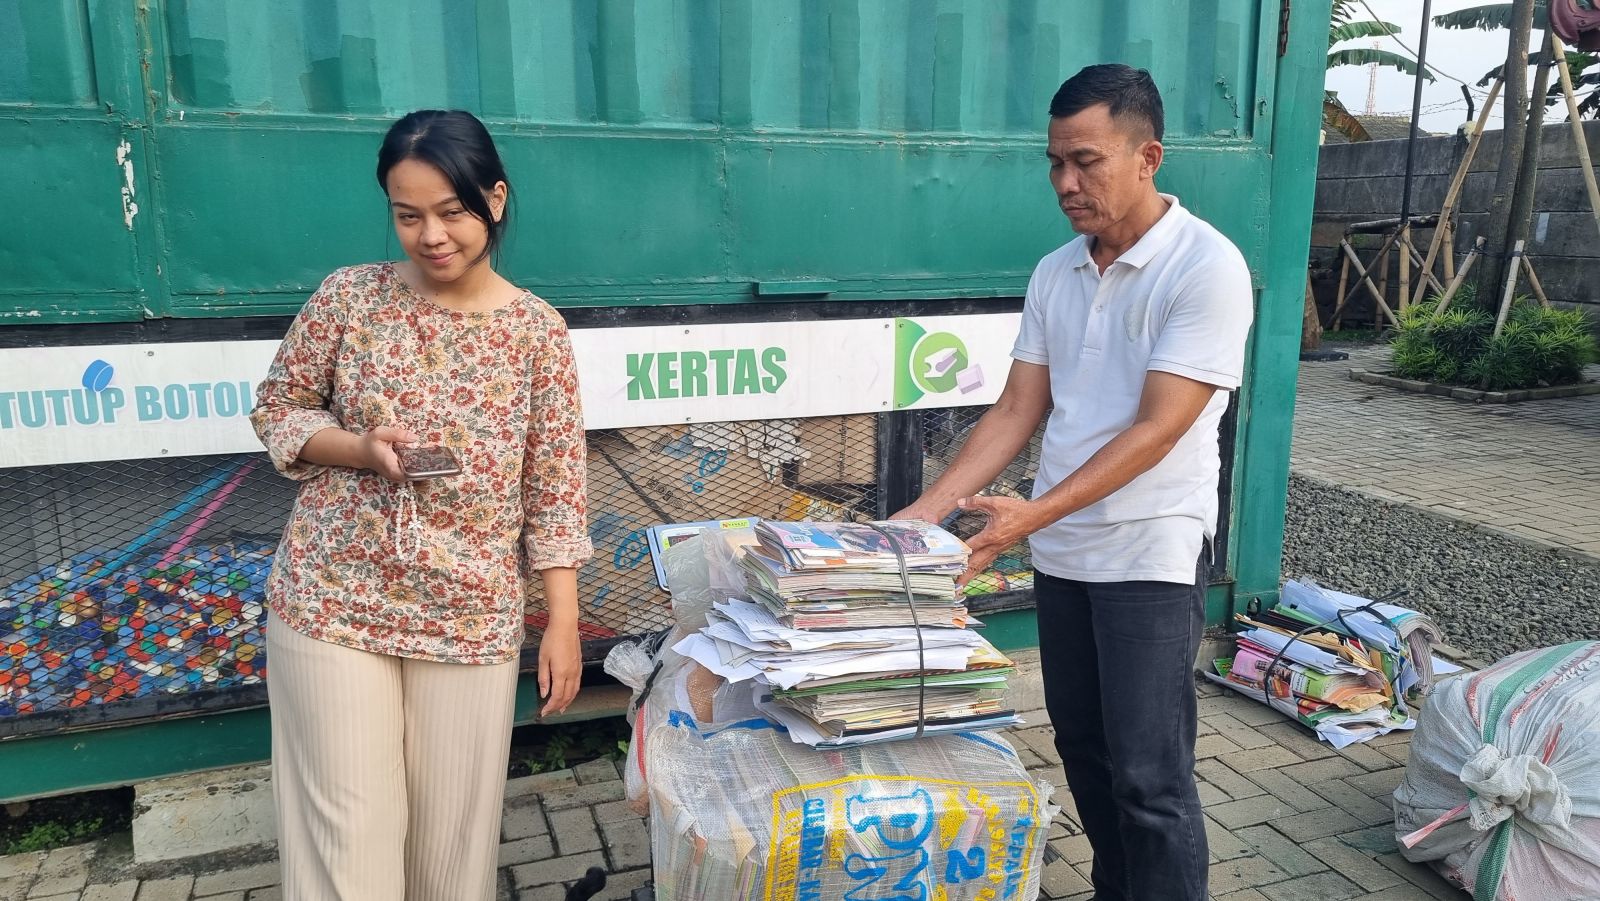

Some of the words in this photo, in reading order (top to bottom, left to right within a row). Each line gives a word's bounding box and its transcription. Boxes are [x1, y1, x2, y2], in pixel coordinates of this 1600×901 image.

[626, 346, 787, 400] KERTAS
[0, 387, 124, 429] TUTUP
[945, 846, 986, 884] 2
